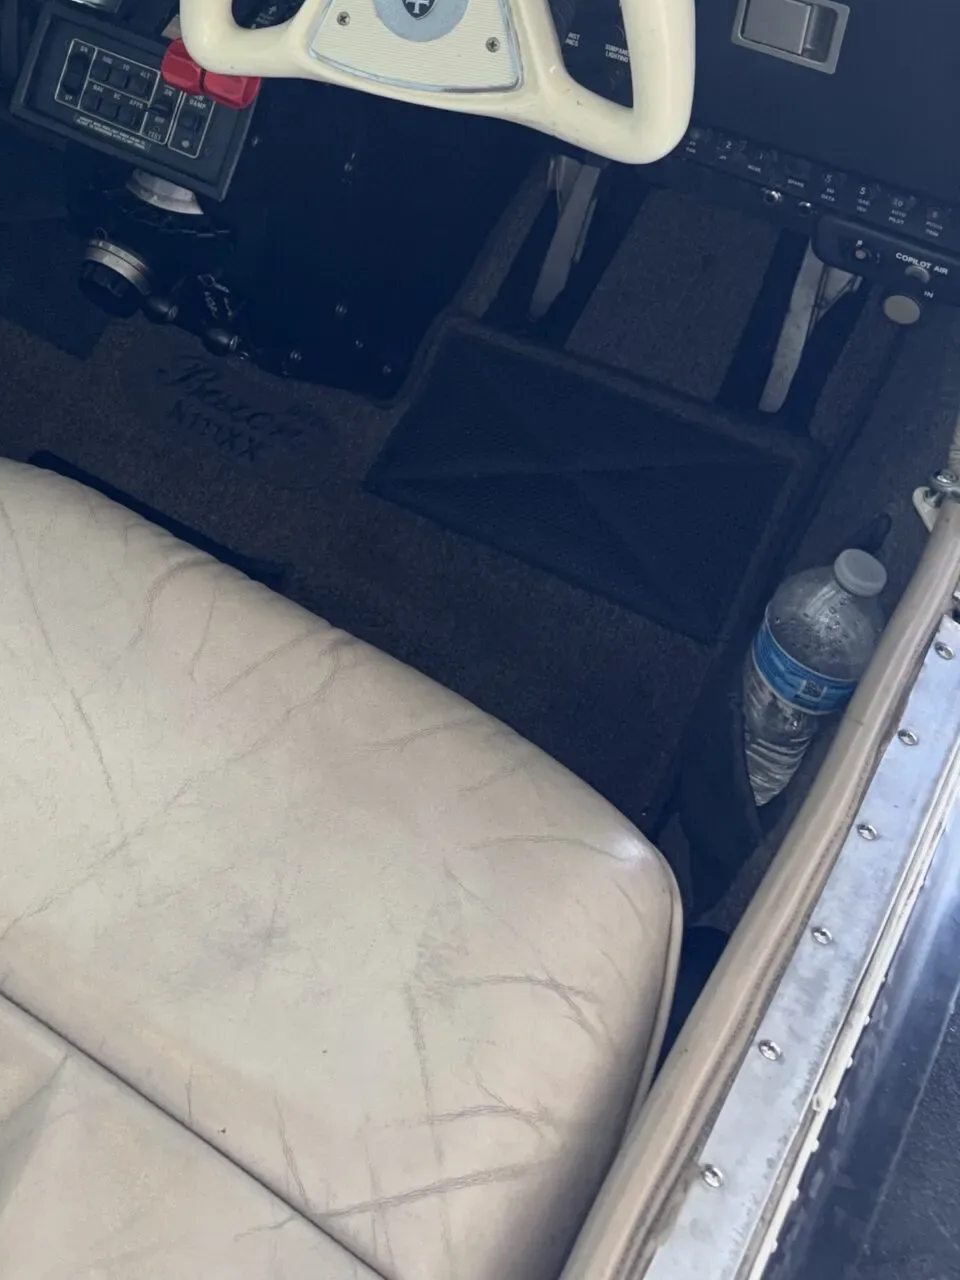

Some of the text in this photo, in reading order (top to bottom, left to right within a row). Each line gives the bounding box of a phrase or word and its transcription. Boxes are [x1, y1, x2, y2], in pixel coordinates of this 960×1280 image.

[896, 252, 949, 275] COPILOT AIR
[924, 290, 934, 299] IN
